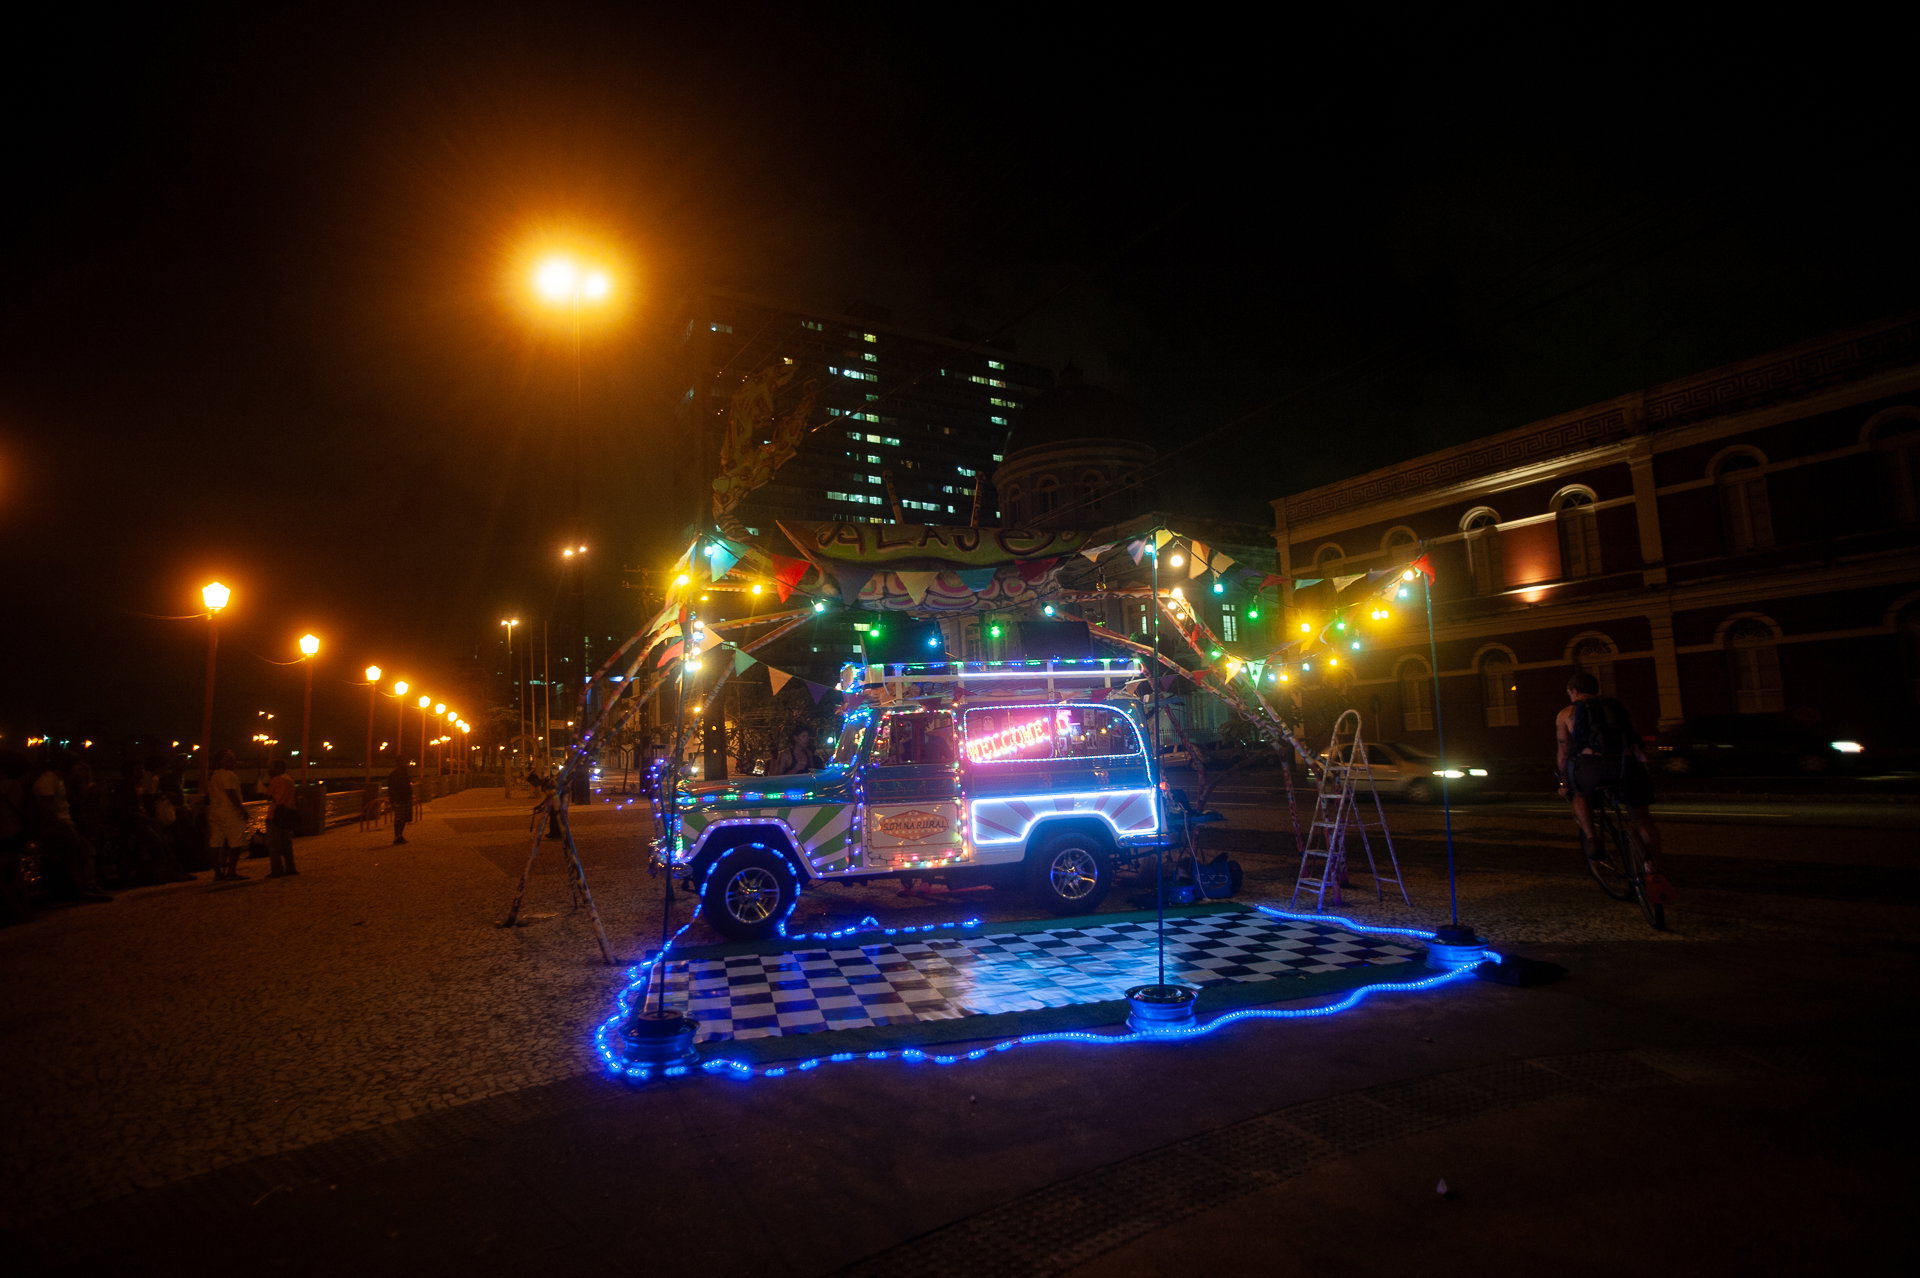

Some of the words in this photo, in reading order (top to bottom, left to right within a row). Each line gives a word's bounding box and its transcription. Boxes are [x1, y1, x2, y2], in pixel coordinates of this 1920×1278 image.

[967, 721, 1045, 760] WELCOME
[883, 821, 902, 831] SOM
[904, 821, 915, 830] NA
